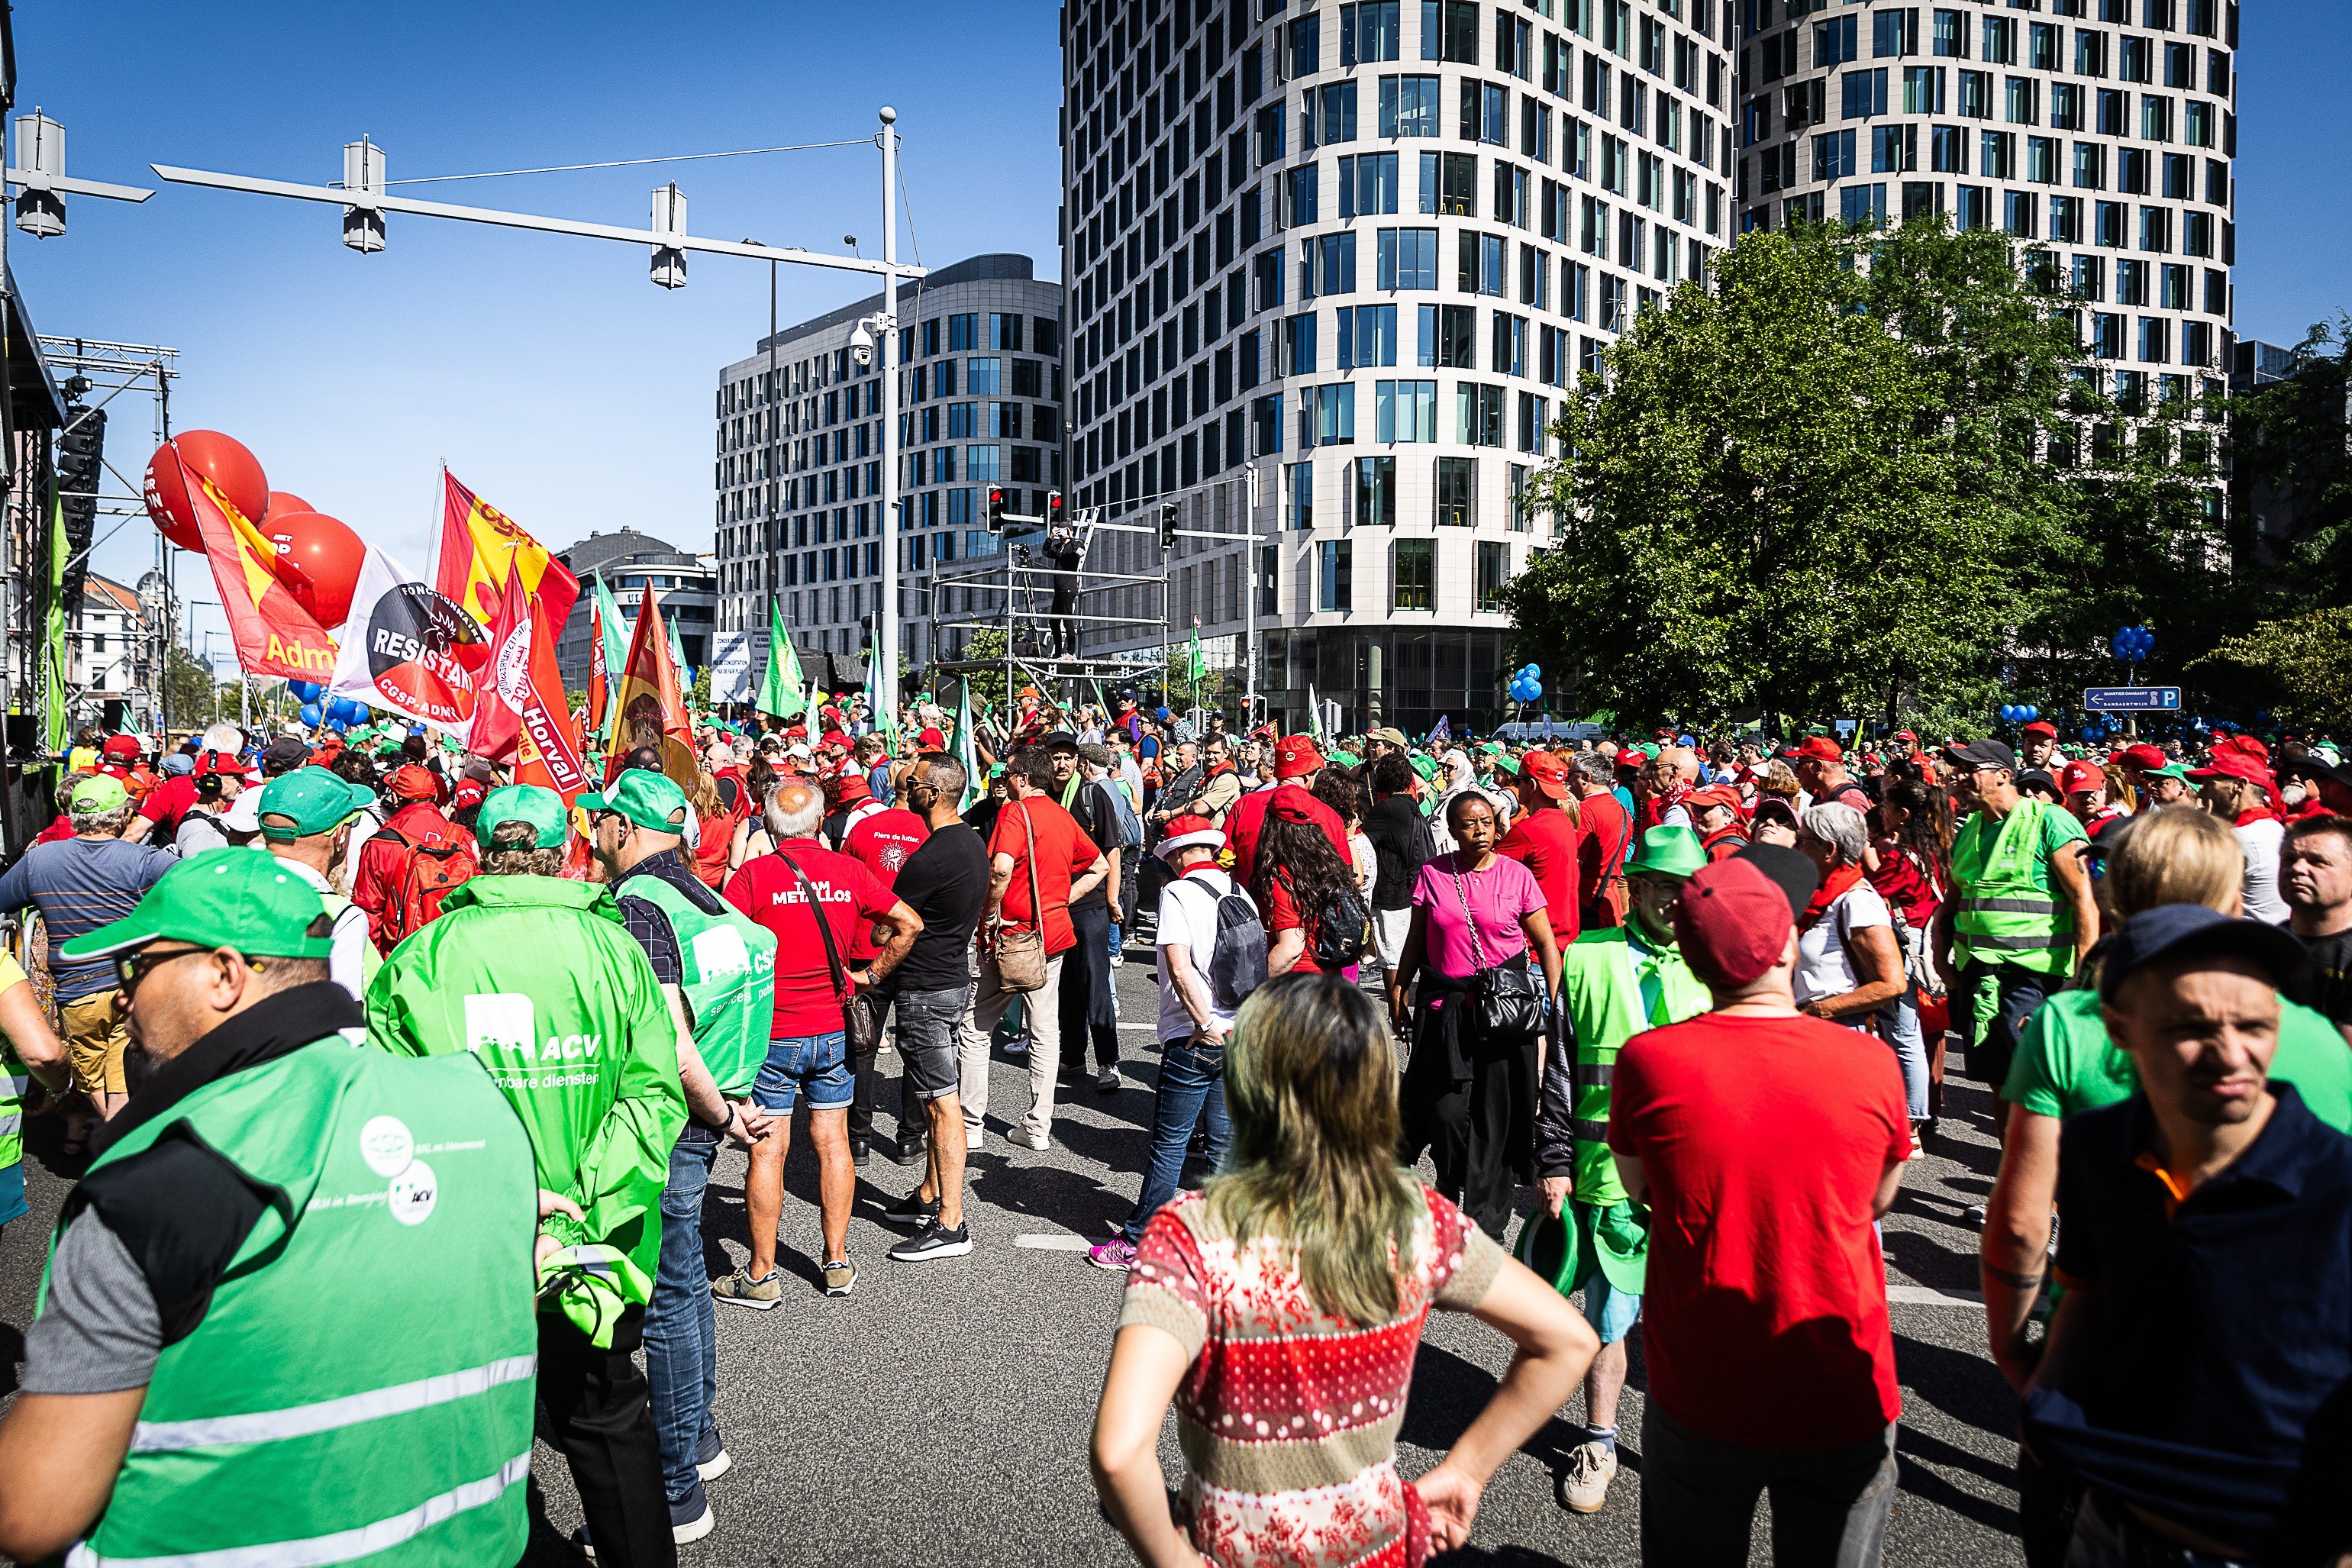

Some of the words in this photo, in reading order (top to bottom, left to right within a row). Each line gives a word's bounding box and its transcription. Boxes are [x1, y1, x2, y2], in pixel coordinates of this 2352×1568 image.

[146, 492, 163, 509] ON
[266, 633, 340, 671] Adm
[2164, 691, 2176, 706] P
[523, 707, 579, 784] Horval
[794, 881, 830, 892] TAM
[710, 992, 752, 1016] services
[540, 1034, 602, 1061] ACV
[411, 1189, 433, 1203] ACV
